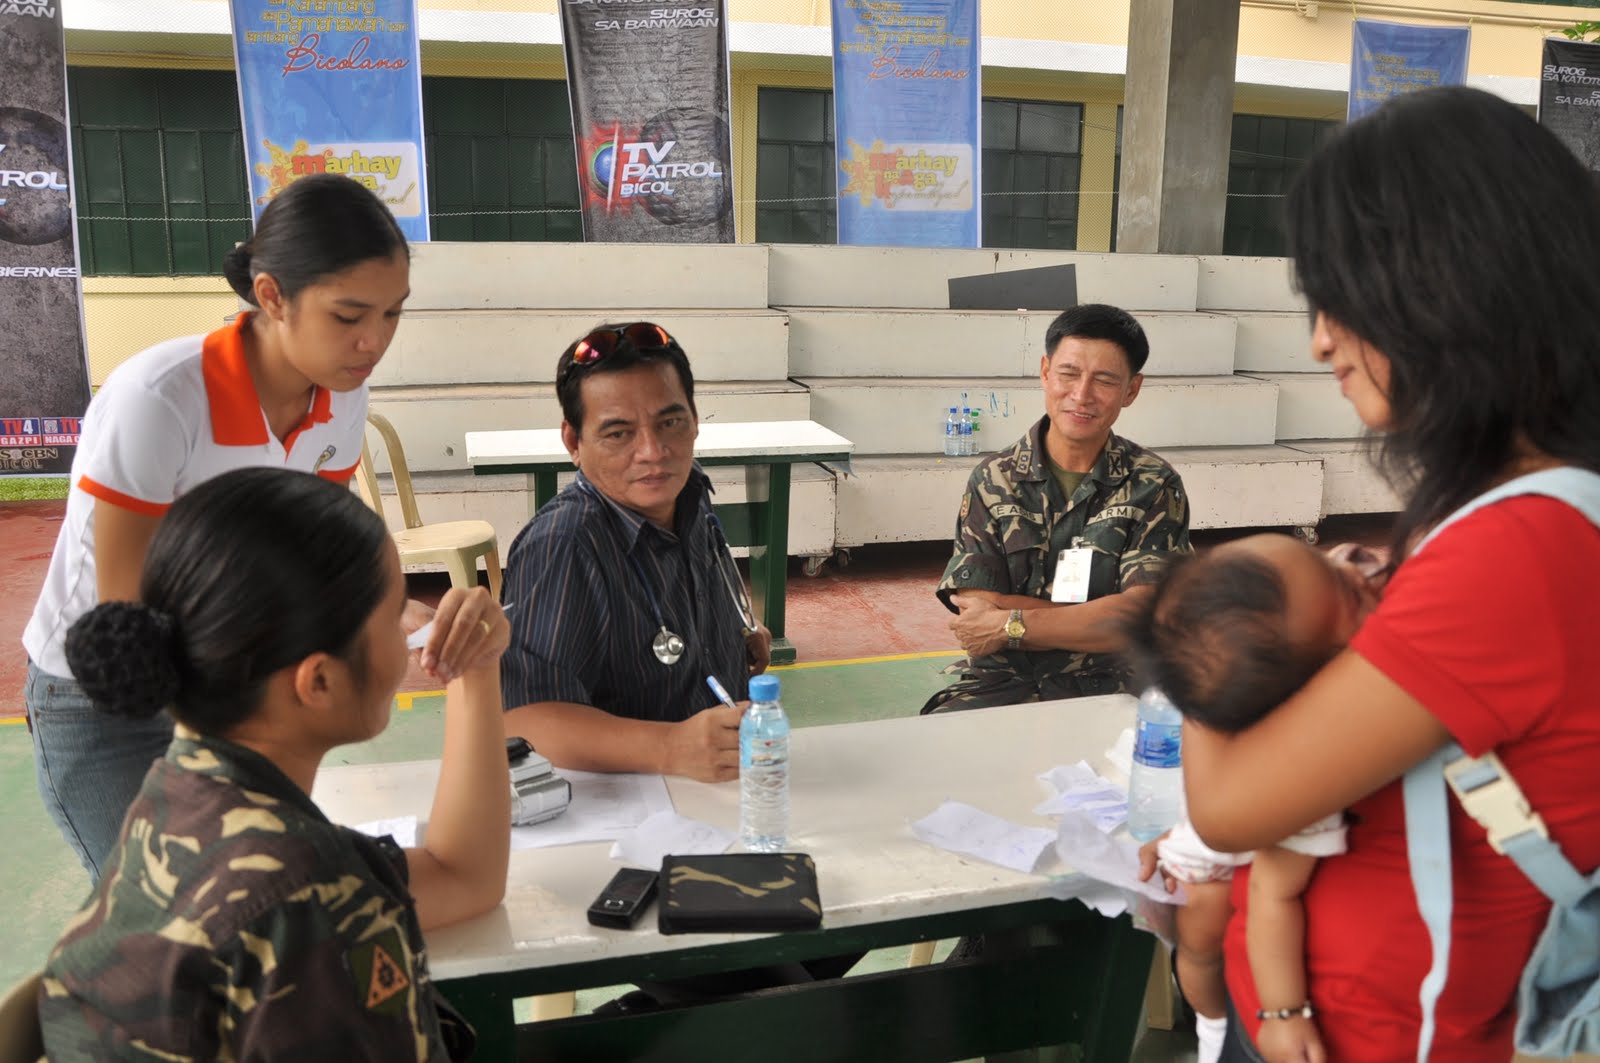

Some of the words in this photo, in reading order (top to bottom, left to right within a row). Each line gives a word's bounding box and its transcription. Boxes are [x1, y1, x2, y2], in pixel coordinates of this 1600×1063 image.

[649, 8, 715, 19] SUROG
[595, 20, 621, 31] SA
[624, 18, 719, 30] BANWAAN
[281, 33, 410, 78] Bicolano
[864, 45, 970, 87] Bicolano
[1543, 65, 1587, 76] SUROG
[1543, 73, 1560, 82] SA
[1555, 96, 1571, 104] SA
[622, 141, 677, 164] TV
[292, 149, 401, 180] marhay
[870, 149, 959, 177] marhay
[621, 162, 723, 182] PATROL
[620, 181, 675, 198] BICOL
[1095, 506, 1138, 521] ARMY
